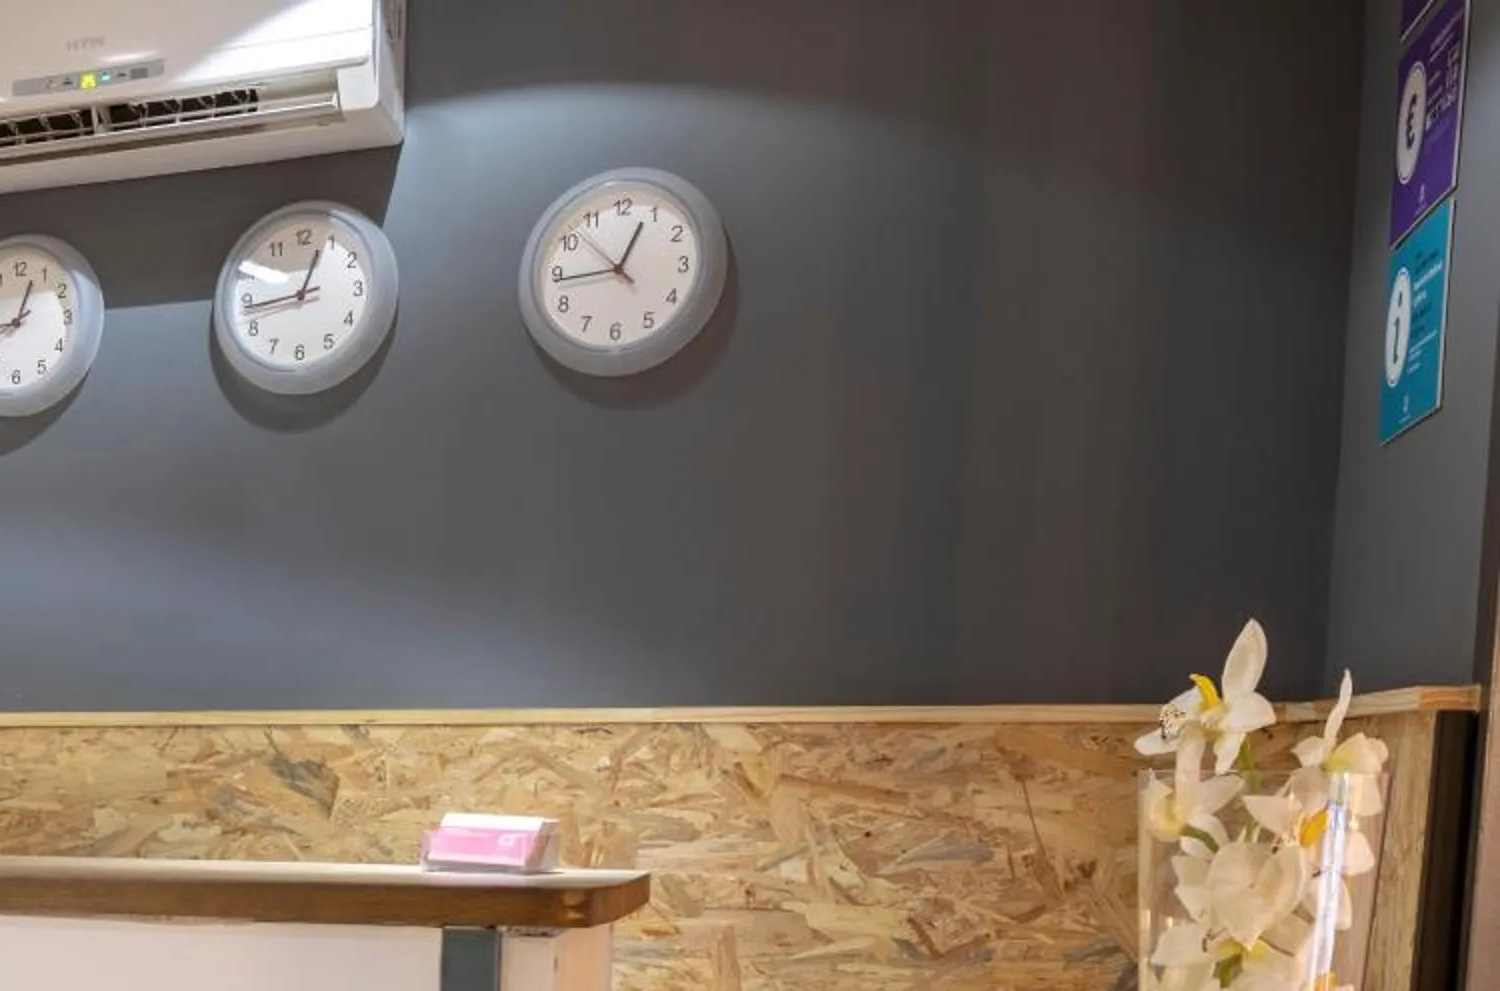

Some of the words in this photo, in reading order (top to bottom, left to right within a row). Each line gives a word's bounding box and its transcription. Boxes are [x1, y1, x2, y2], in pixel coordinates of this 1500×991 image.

[613, 199, 633, 216] 12
[650, 207, 659, 222] 1
[582, 212, 599, 228] 11
[295, 229, 313, 246] 12
[328, 235, 335, 250] 1
[561, 234, 579, 251] 10
[670, 225, 684, 243] 2
[269, 242, 284, 257] 11
[347, 251, 357, 269] 2
[677, 255, 689, 274] 3
[12, 261, 28, 277] 12
[41, 268, 48, 282] 1
[551, 265, 563, 283] 9
[57, 283, 67, 299] 2
[353, 280, 363, 297] 3
[665, 287, 678, 305] 4
[241, 293, 253, 309] 9
[557, 295, 569, 313] 8
[63, 309, 73, 326] 3
[343, 310, 353, 327] 4
[580, 315, 593, 333] 7
[643, 311, 655, 329] 5
[248, 319, 259, 337] 8
[609, 323, 622, 341] 6
[55, 337, 63, 353] 4
[269, 338, 279, 354] 7
[323, 334, 335, 350] 5
[295, 344, 305, 361] 6
[36, 359, 47, 375] 5
[11, 369, 21, 385] 6
